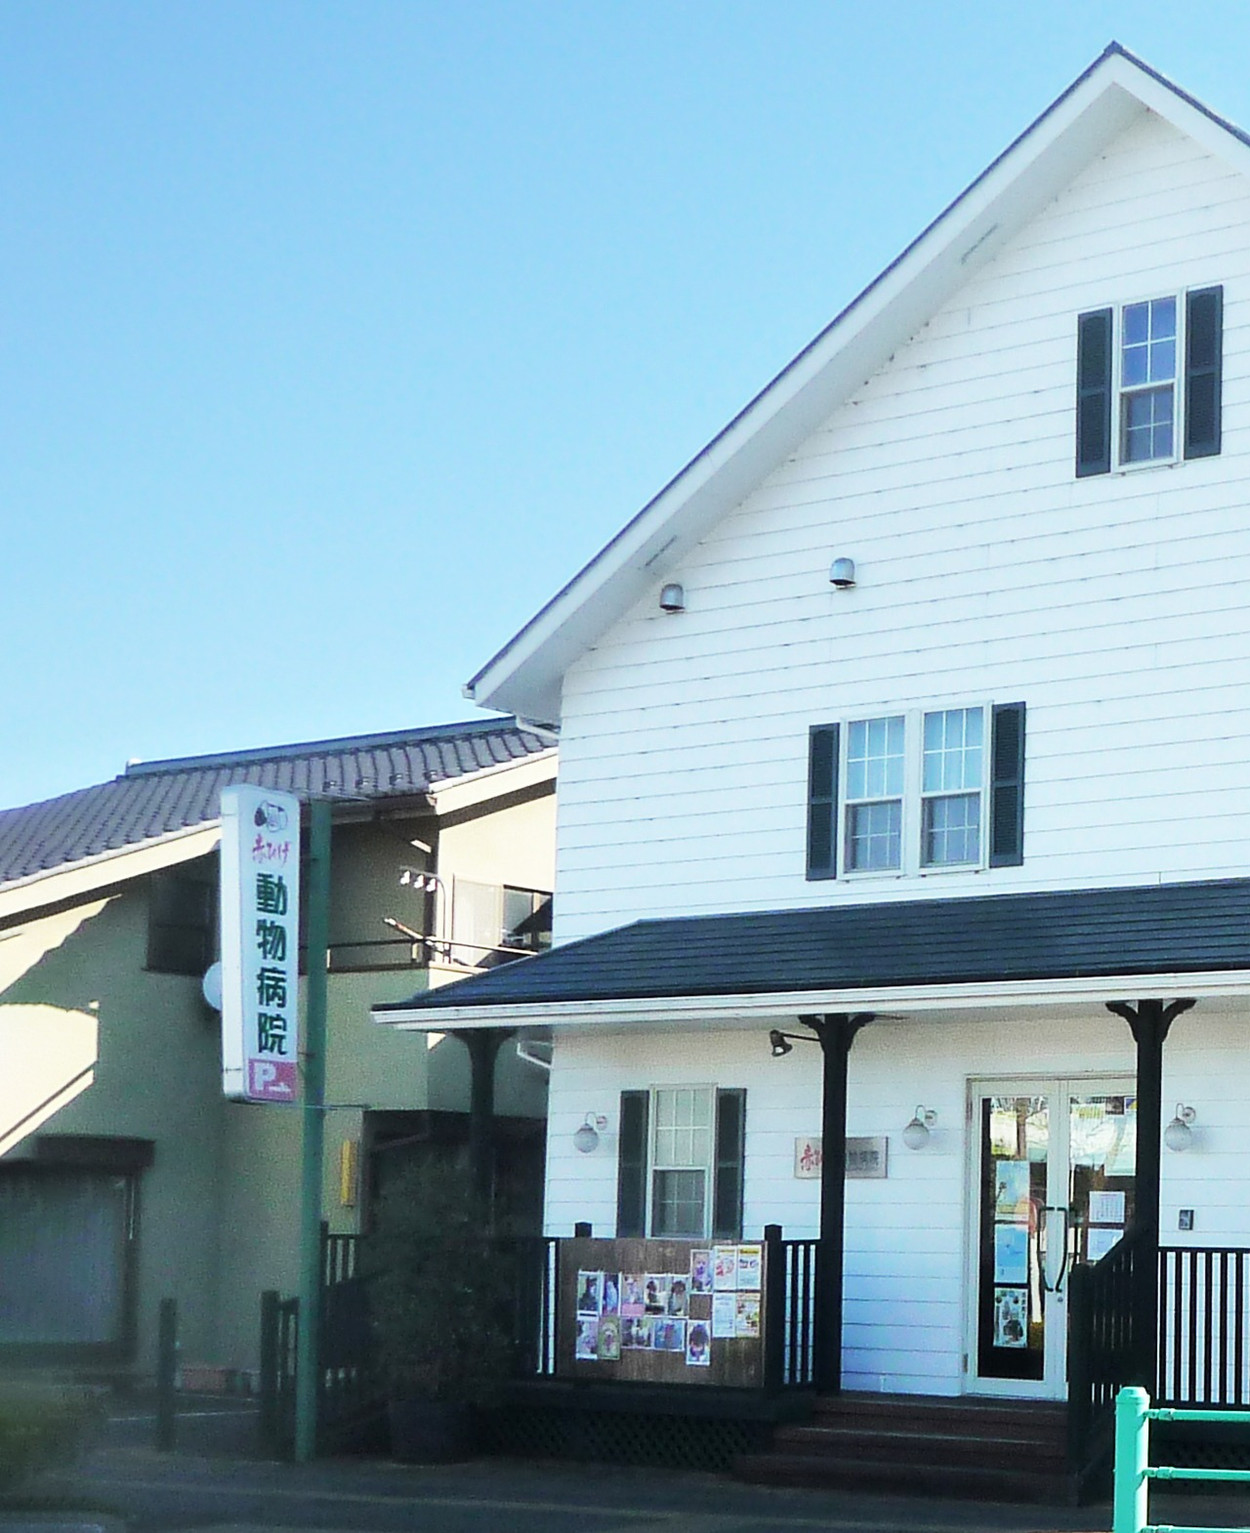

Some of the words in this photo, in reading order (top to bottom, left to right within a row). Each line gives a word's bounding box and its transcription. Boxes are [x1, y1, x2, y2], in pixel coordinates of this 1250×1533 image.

[252, 833, 291, 868] 赤ひげ
[256, 872, 288, 1056] 動物病院
[254, 1062, 276, 1091] P
